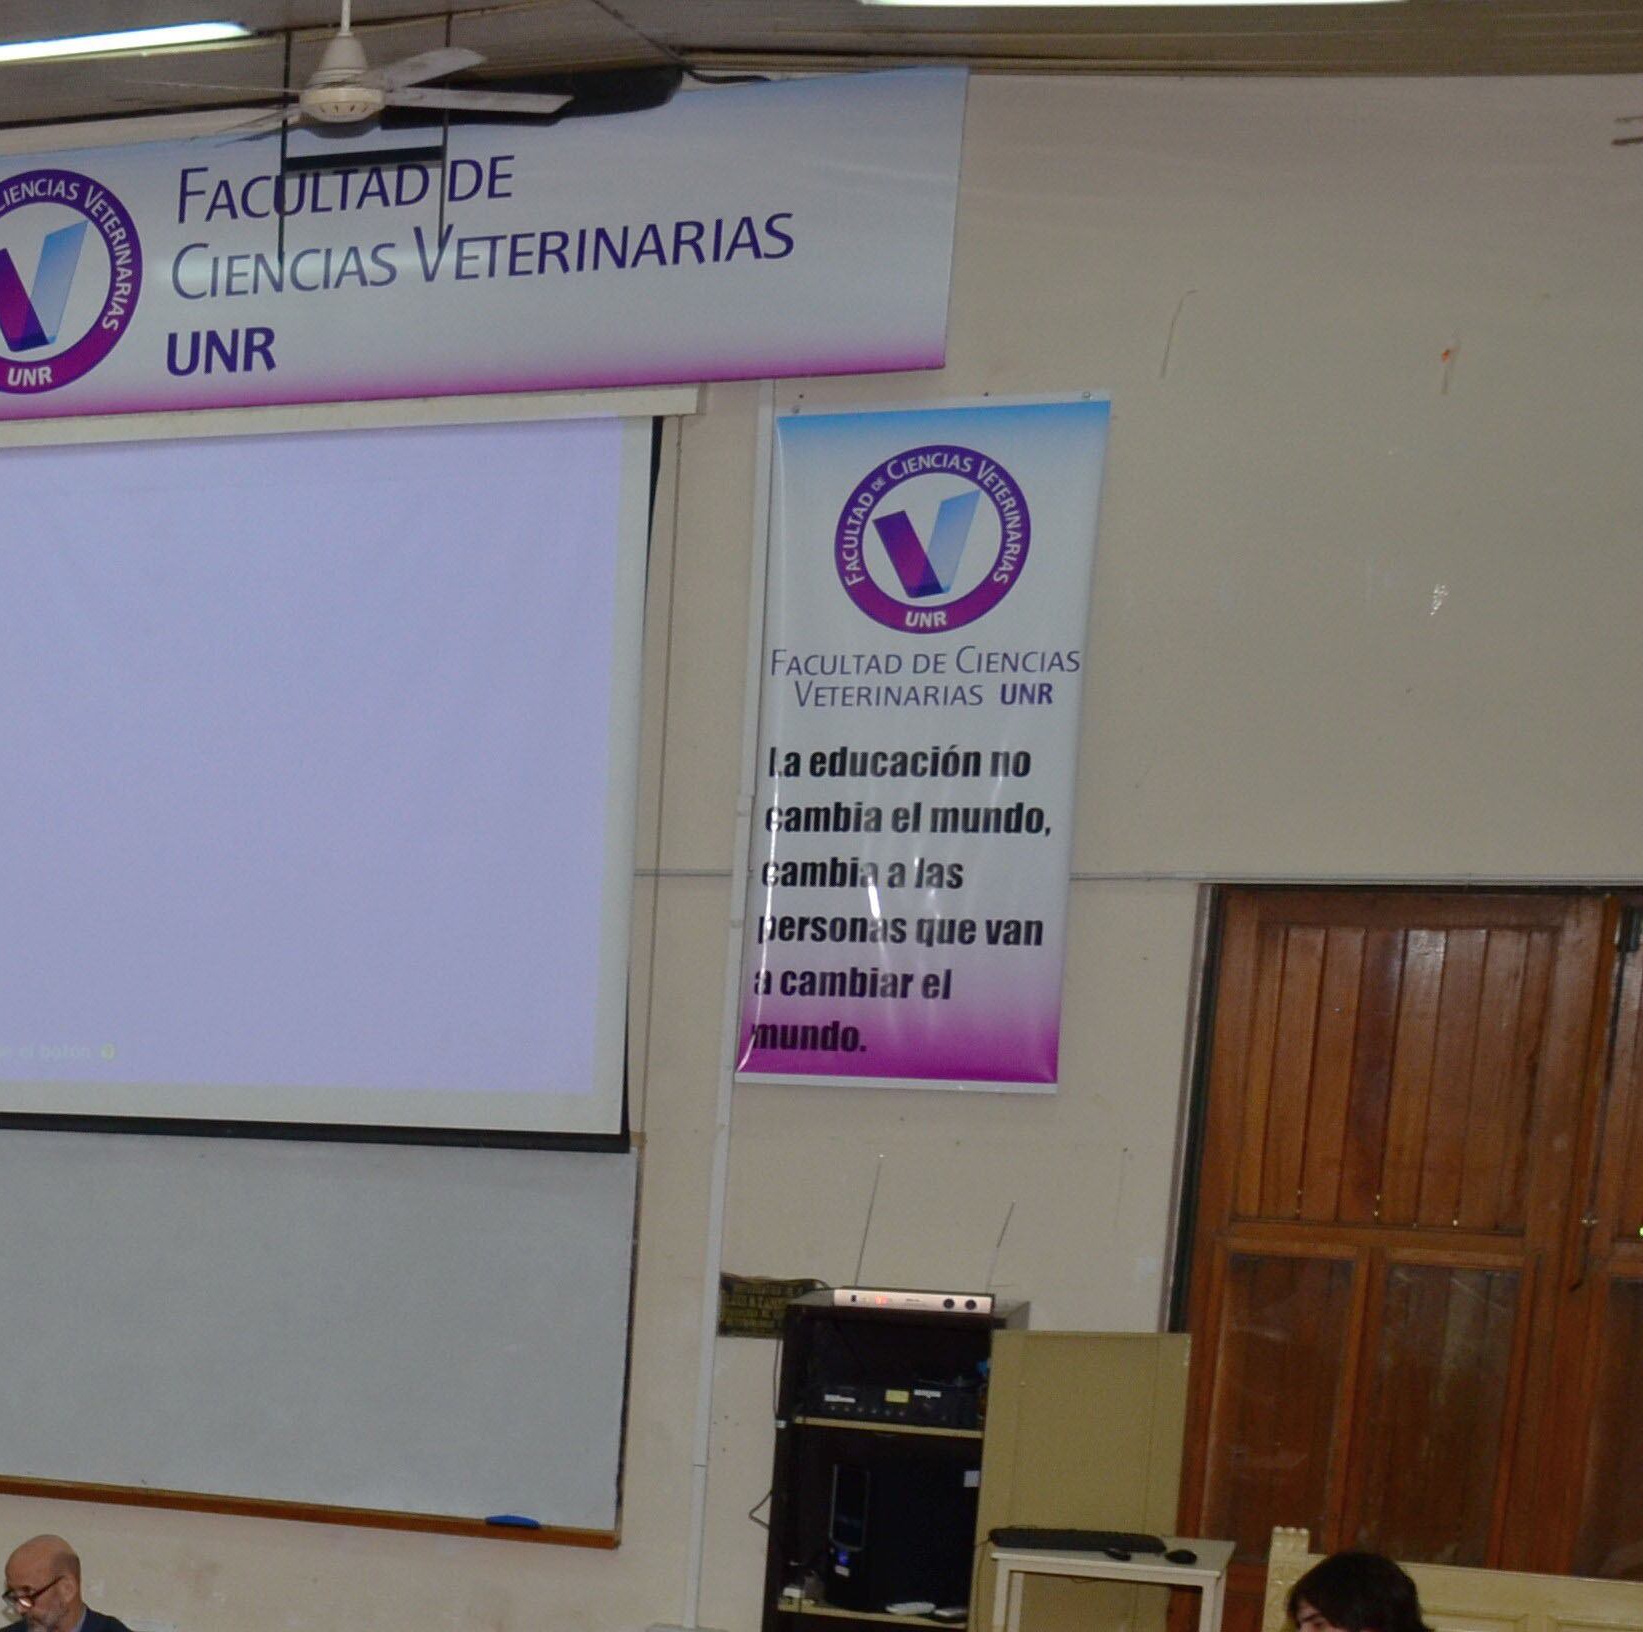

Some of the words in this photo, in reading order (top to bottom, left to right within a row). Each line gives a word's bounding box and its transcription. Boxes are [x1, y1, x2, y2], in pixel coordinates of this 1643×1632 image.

[178, 164, 429, 224] FACULTAD
[447, 155, 515, 204] DE
[84, 185, 133, 331] VETERINARIAS
[171, 241, 398, 299] CIENCIAS
[413, 212, 796, 283] VETERINARIAS
[165, 326, 277, 376] UNR
[8, 366, 52, 387] UNR
[842, 492, 874, 587] FACULTAD
[886, 451, 974, 480] CIENCIAS
[975, 459, 1024, 585] VETERINARIAS
[905, 609, 948, 628] UNR
[770, 648, 903, 677] FACULTAD
[912, 651, 947, 675] DE
[955, 644, 1080, 675] CIENCIAS
[794, 681, 983, 708] VETERINARIAS
[999, 681, 1053, 706] UNR
[769, 746, 802, 779] La
[809, 743, 982, 779] educación
[990, 751, 1030, 779] no
[765, 803, 885, 835] cambia
[891, 802, 922, 834] el
[929, 801, 1052, 838] mundo,
[762, 858, 879, 889] cambia
[887, 864, 906, 889] a
[913, 857, 964, 890] las
[758, 915, 907, 949] personas
[916, 919, 976, 949] que
[984, 916, 1044, 947] van
[754, 970, 774, 996] a
[779, 968, 914, 1001] cambiar
[920, 968, 952, 1001] el
[750, 1019, 867, 1054] mundo.
